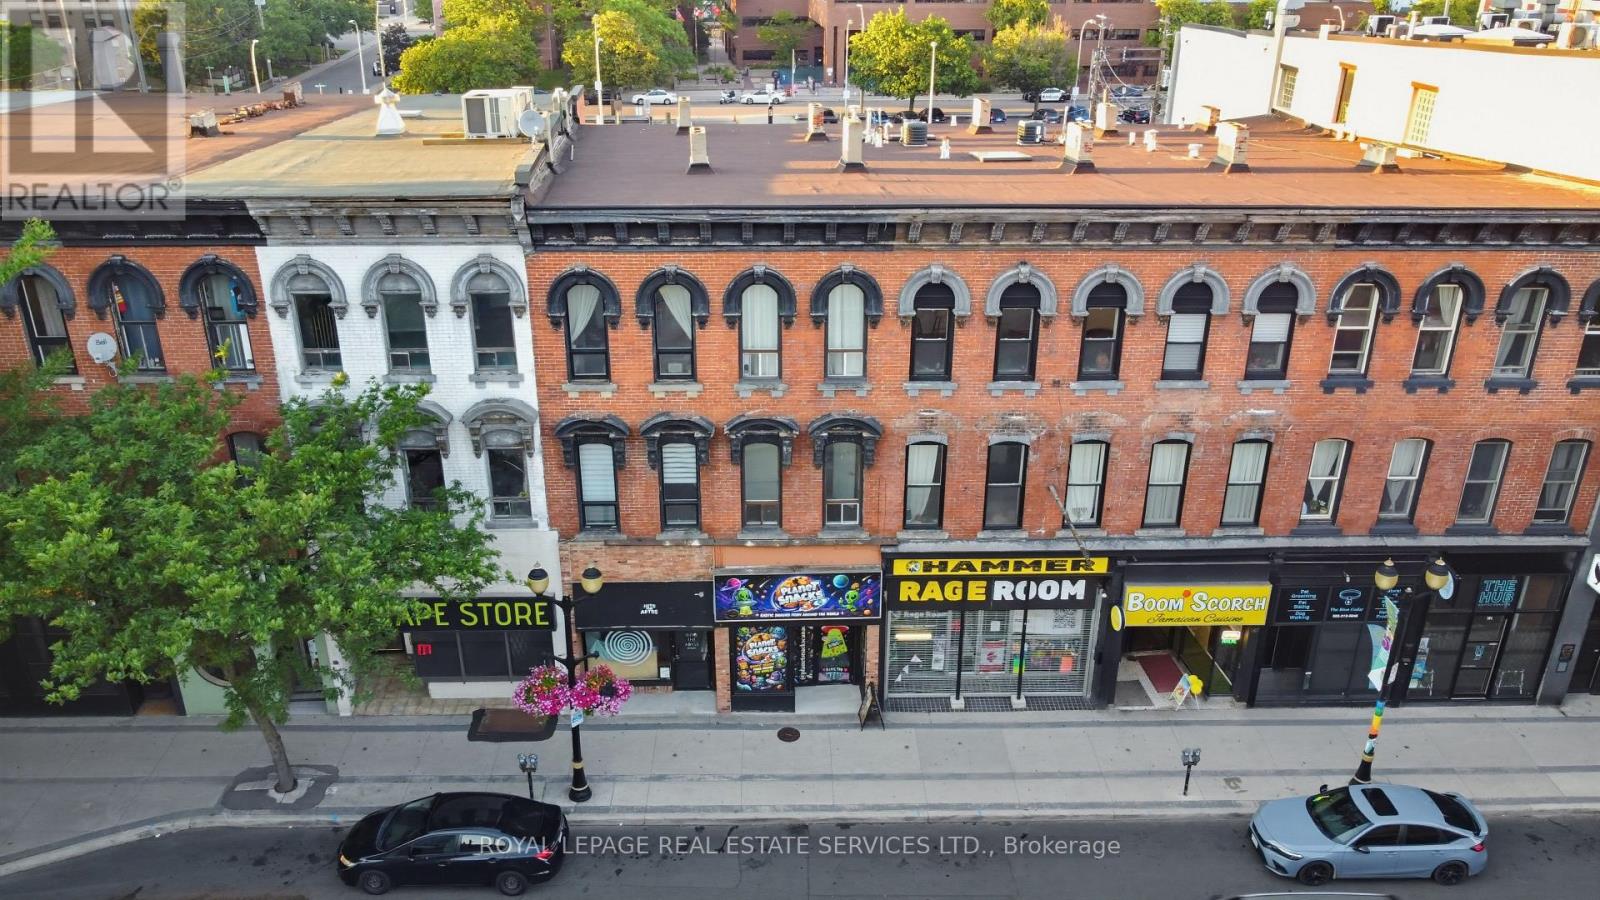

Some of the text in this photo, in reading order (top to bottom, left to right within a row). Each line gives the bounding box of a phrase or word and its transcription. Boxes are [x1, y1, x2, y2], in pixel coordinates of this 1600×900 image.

[922, 559, 1096, 573] HAMMER
[899, 579, 1087, 602] RAGE ROOM
[1483, 579, 1518, 592] THE
[1478, 591, 1515, 604] HUB
[397, 602, 550, 627] APE STORE
[1147, 613, 1244, 624] Jamaican Cuisine
